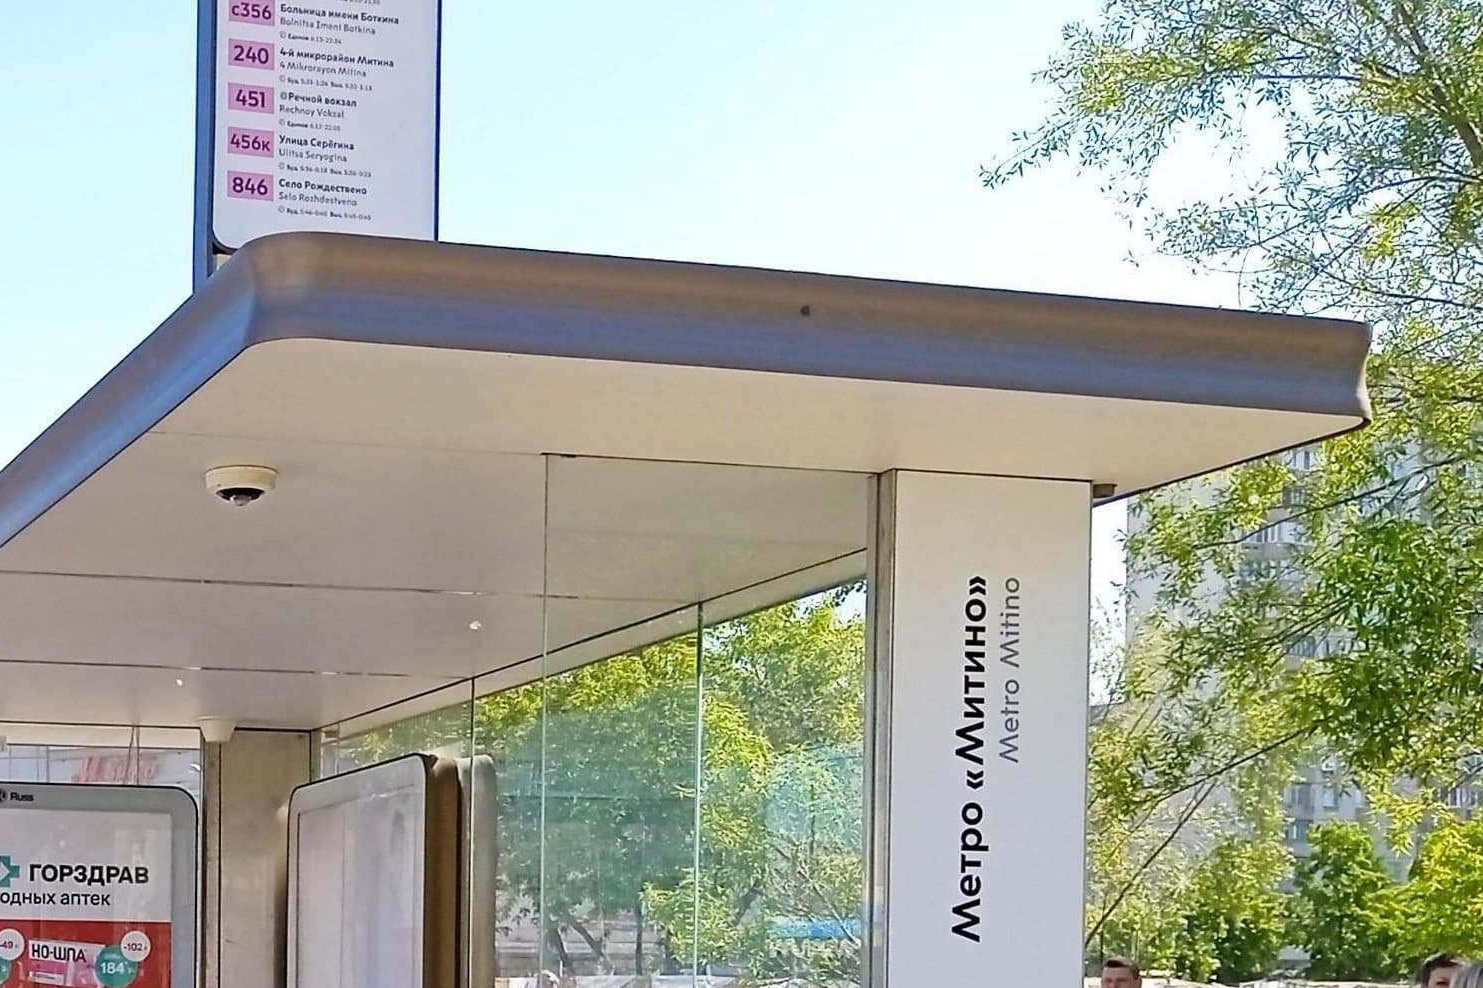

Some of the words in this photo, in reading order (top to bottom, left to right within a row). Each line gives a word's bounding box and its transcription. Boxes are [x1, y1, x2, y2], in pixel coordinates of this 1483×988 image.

[231, 2, 272, 20] с356
[280, 3, 326, 17] Больница
[328, 11, 359, 21] имени
[361, 12, 400, 25] Боткина
[316, 21, 342, 31] Imeni
[343, 24, 376, 35] Botkina
[233, 45, 269, 64] 240
[280, 47, 295, 58] 4-й
[296, 51, 355, 64] микрорайон
[357, 56, 395, 67] Митина
[280, 61, 285, 69] 4
[287, 61, 336, 76] Mikrorayon
[338, 67, 367, 77] Mitina
[236, 89, 265, 108] 451
[288, 92, 322, 104] Речной
[325, 97, 357, 107] вокзал
[279, 104, 314, 117] Rechnoy
[316, 108, 344, 118] Vokzal
[230, 133, 270, 152] 456к
[279, 135, 308, 147] Улица
[310, 137, 355, 150] Серёгина
[279, 149, 304, 159] Ulitsa
[305, 151, 347, 162] Seryogina
[232, 176, 268, 195] 846
[279, 178, 302, 189] Село
[304, 181, 367, 195] Рождествено
[279, 192, 297, 201] Selo
[299, 193, 357, 206] Rozhdestveno
[999, 576, 1021, 668] Mitino
[955, 575, 987, 790] «Митино»
[999, 679, 1020, 764] Metro
[29, 862, 150, 885] ГОРЗДРАВ
[951, 801, 989, 943] Метро
[60, 892, 111, 907] аптек
[32, 944, 86, 963] НО-ШПА
